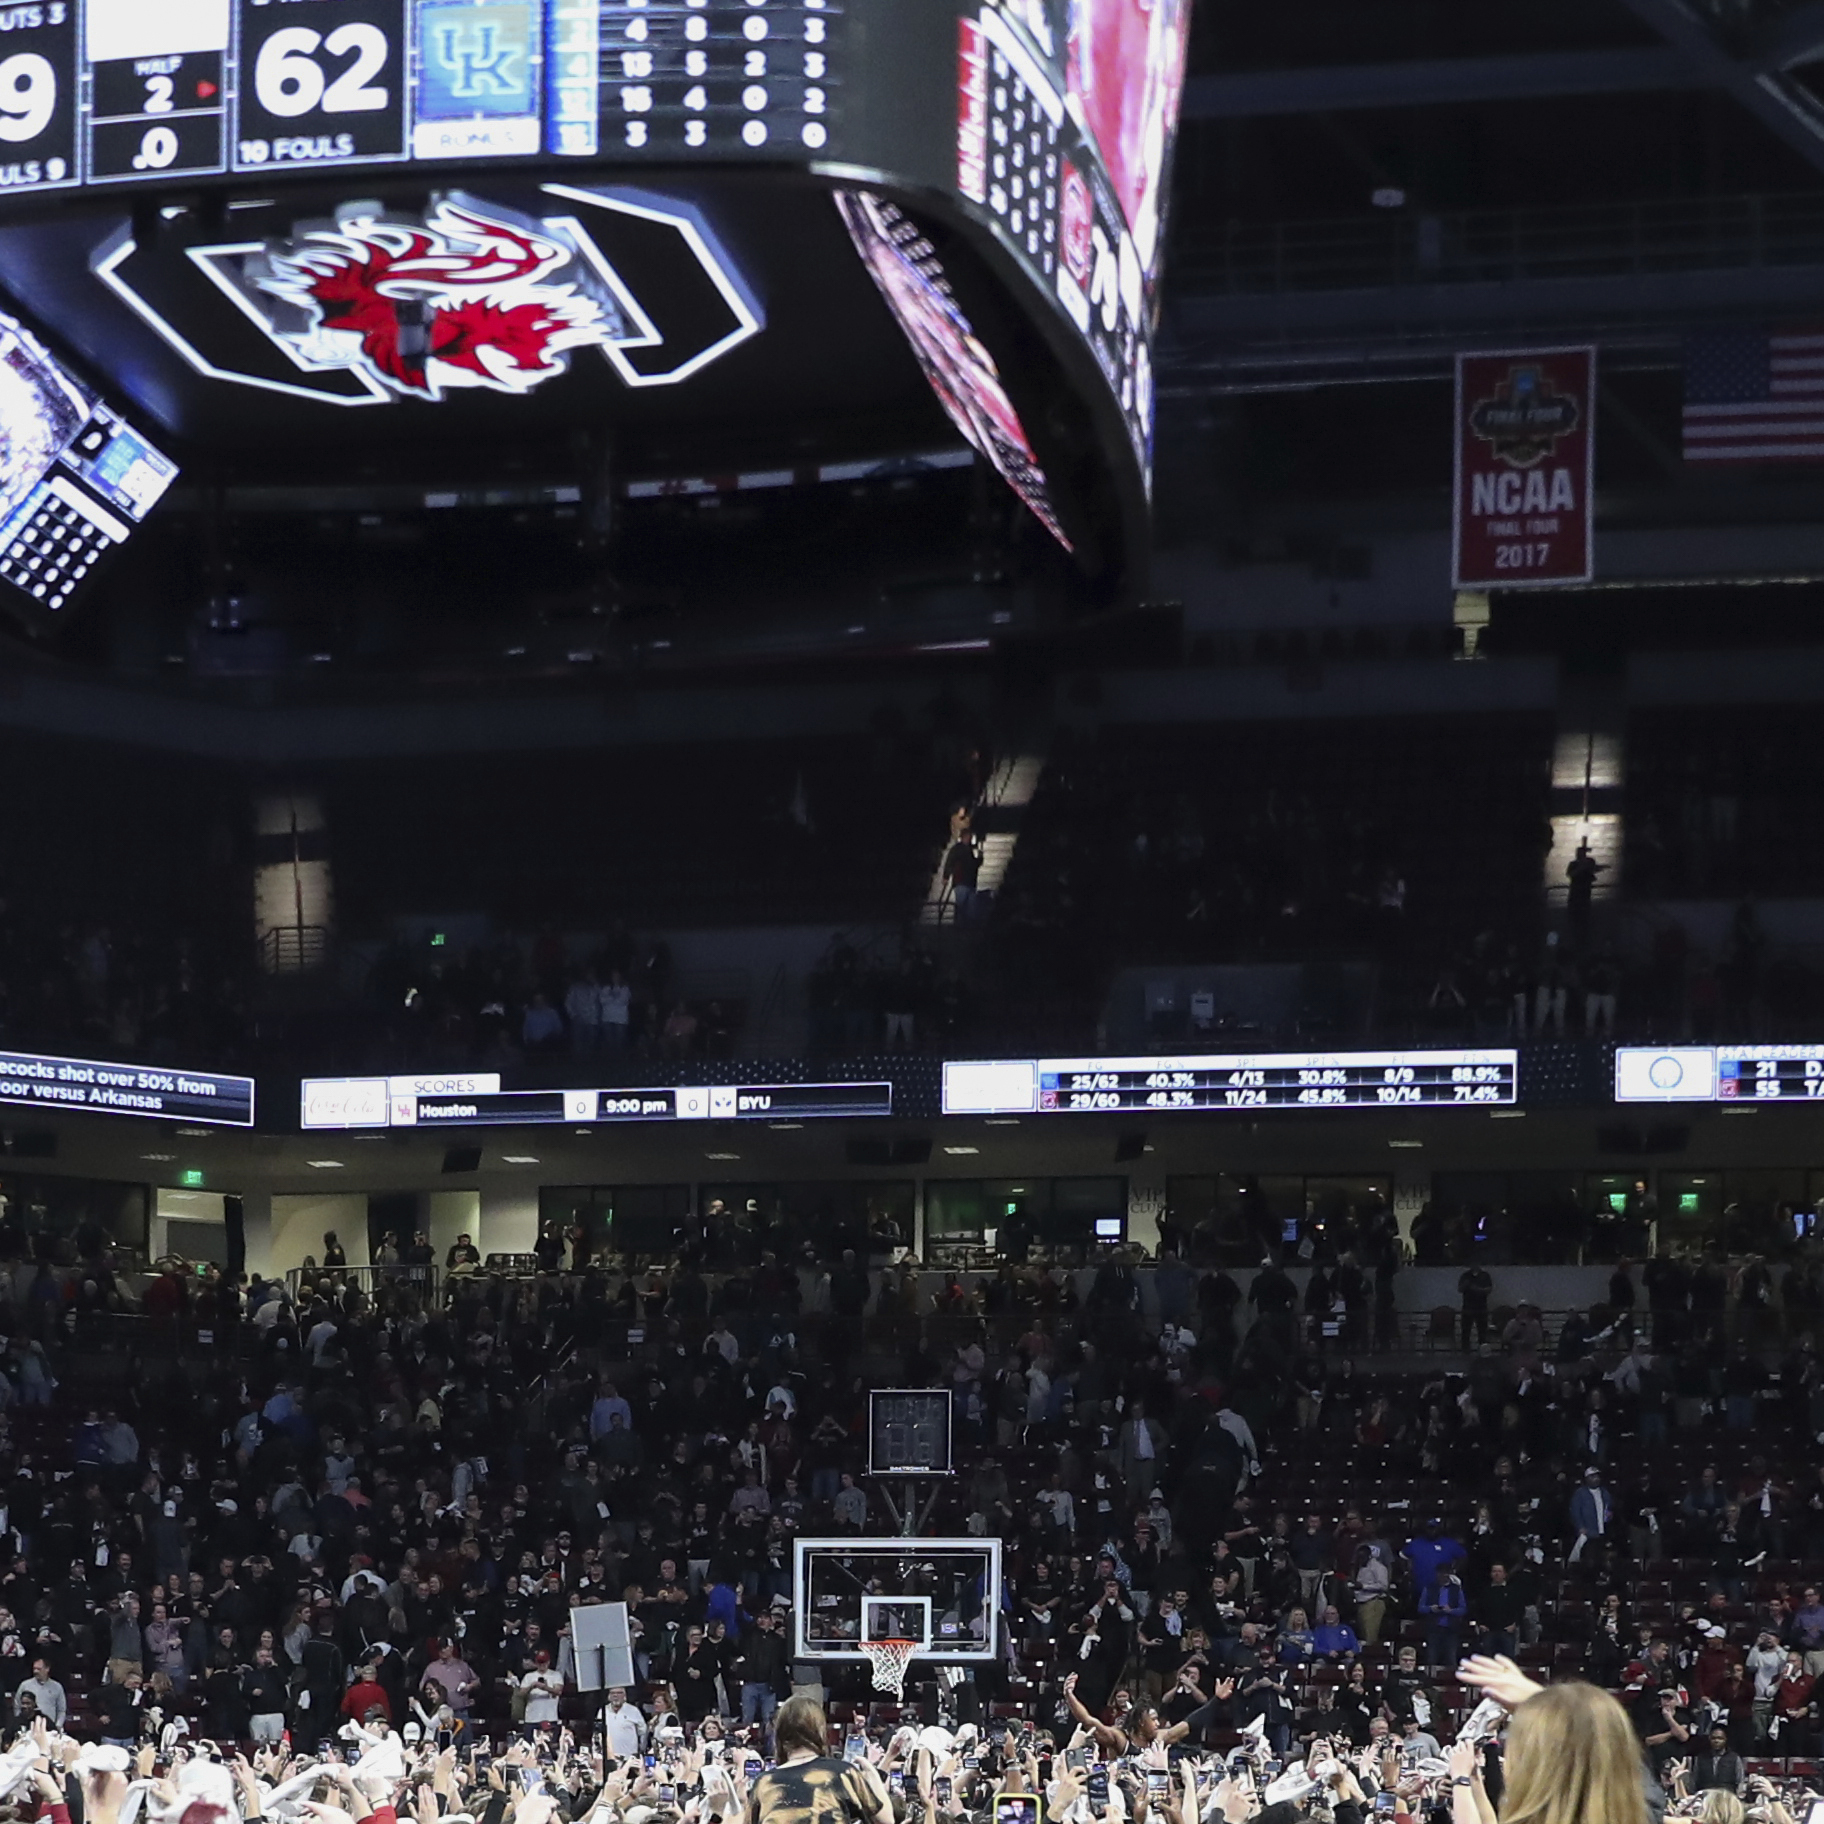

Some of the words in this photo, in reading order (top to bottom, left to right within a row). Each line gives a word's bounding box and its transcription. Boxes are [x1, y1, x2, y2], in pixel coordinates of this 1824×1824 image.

[48, 4, 66, 26] 3
[255, 23, 389, 117] 62
[142, 76, 173, 113] 2
[240, 139, 268, 164] 10
[274, 134, 354, 160] FOULS
[46, 157, 66, 181] 9
[1471, 468, 1575, 516] NCAA
[1486, 521, 1521, 537] FINAL
[1526, 518, 1559, 535] FOUR
[1495, 543, 1550, 569] 2017
[58, 1065, 95, 1084] shot
[96, 1070, 136, 1088] over
[138, 1073, 173, 1091] 50%
[176, 1077, 216, 1095] from
[1071, 1073, 1119, 1091] 25/62
[1145, 1073, 1195, 1088] 40.3%
[1228, 1071, 1265, 1088] 4/13
[1298, 1069, 1347, 1085] 30.8%
[1383, 1067, 1414, 1085] 8/9
[1451, 1066, 1501, 1082] 88.9%
[1756, 1061, 1777, 1077] 21
[33, 1084, 86, 1101] versus
[89, 1088, 163, 1109] Arkansas
[414, 1079, 476, 1093] SCORES
[1070, 1092, 1120, 1109] 29/60
[1146, 1091, 1194, 1107] 48.3%
[1224, 1090, 1267, 1106] 11/24
[1297, 1088, 1346, 1104] 45.8%
[1377, 1086, 1421, 1104] 10/14
[1454, 1085, 1499, 1101] 71.4%
[1756, 1080, 1780, 1097] 55
[419, 1104, 477, 1118] Houston
[606, 1100, 640, 1114] 9:00
[642, 1101, 667, 1116] pm
[739, 1096, 771, 1111] BYU
